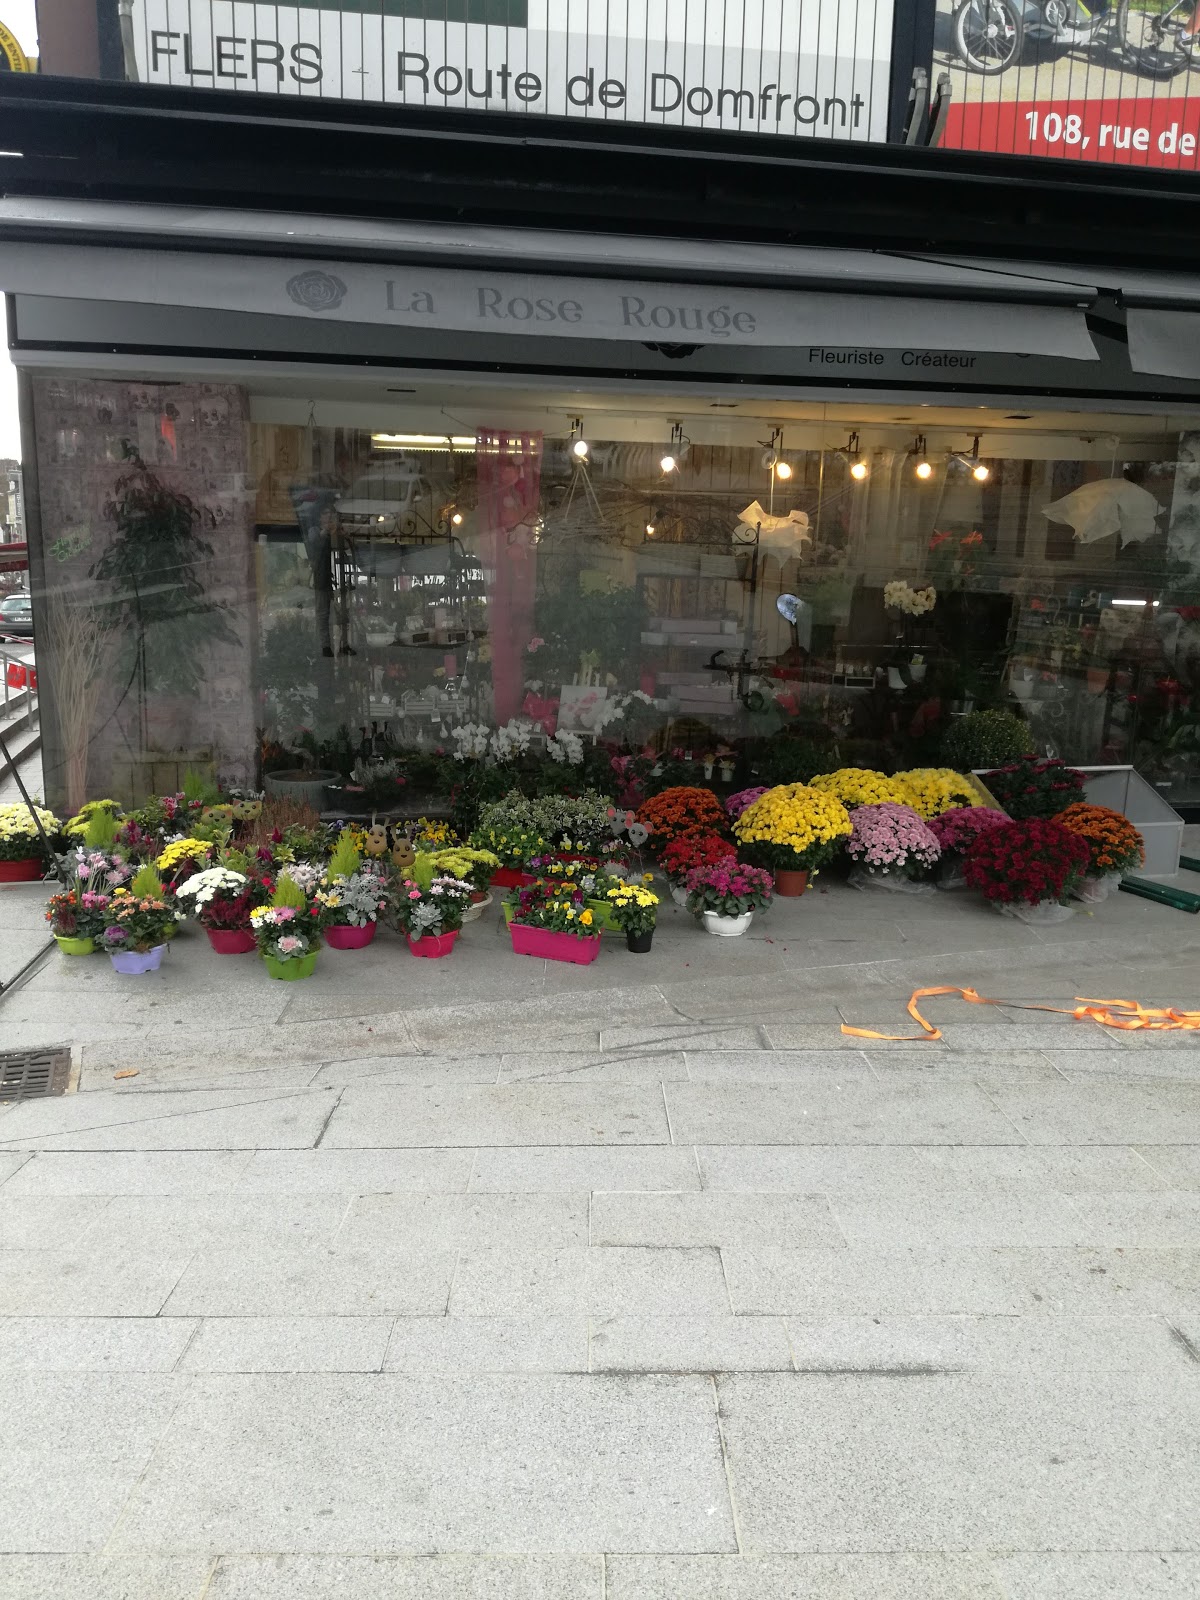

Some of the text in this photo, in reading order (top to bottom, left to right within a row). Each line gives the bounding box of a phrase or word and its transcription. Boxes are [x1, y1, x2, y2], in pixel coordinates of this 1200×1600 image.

[151, 30, 324, 84] FLERS
[397, 50, 542, 102] Route
[566, 67, 626, 109] de
[650, 72, 865, 128] Domfront
[1025, 111, 1196, 156] 108, rue de
[384, 279, 757, 338] La Rose Rouge
[808, 348, 977, 369] Fleuriste Créateur
